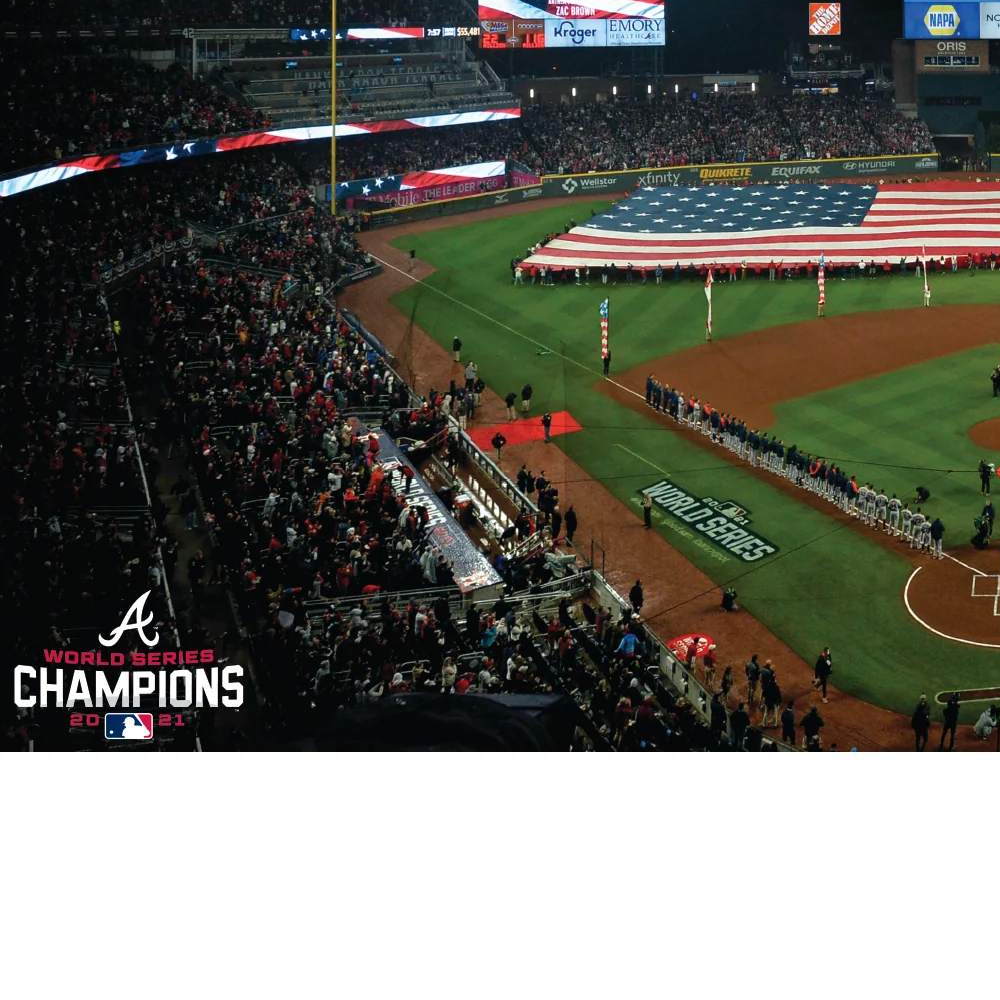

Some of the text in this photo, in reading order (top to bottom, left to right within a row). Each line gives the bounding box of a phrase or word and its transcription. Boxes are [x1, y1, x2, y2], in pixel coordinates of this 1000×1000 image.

[555, 6, 596, 16] ZAC BROWN
[812, 6, 825, 19] THE
[810, 3, 840, 34] HOME
[929, 12, 955, 28] NAPA
[427, 28, 441, 36] 7:57
[457, 27, 480, 36] $55,481
[609, 19, 663, 32] EMORY
[553, 21, 597, 44] Kroger
[936, 41, 967, 51] ORIS
[771, 165, 823, 177] EQUIFAX
[858, 160, 896, 169] HYUNDAI
[638, 171, 681, 186] xfinity
[700, 167, 752, 178] QUIKRETE
[580, 177, 618, 186] Wellstar
[443, 182, 475, 196] LEADER
[641, 481, 714, 522] WORLD
[696, 516, 775, 562] SERIES
